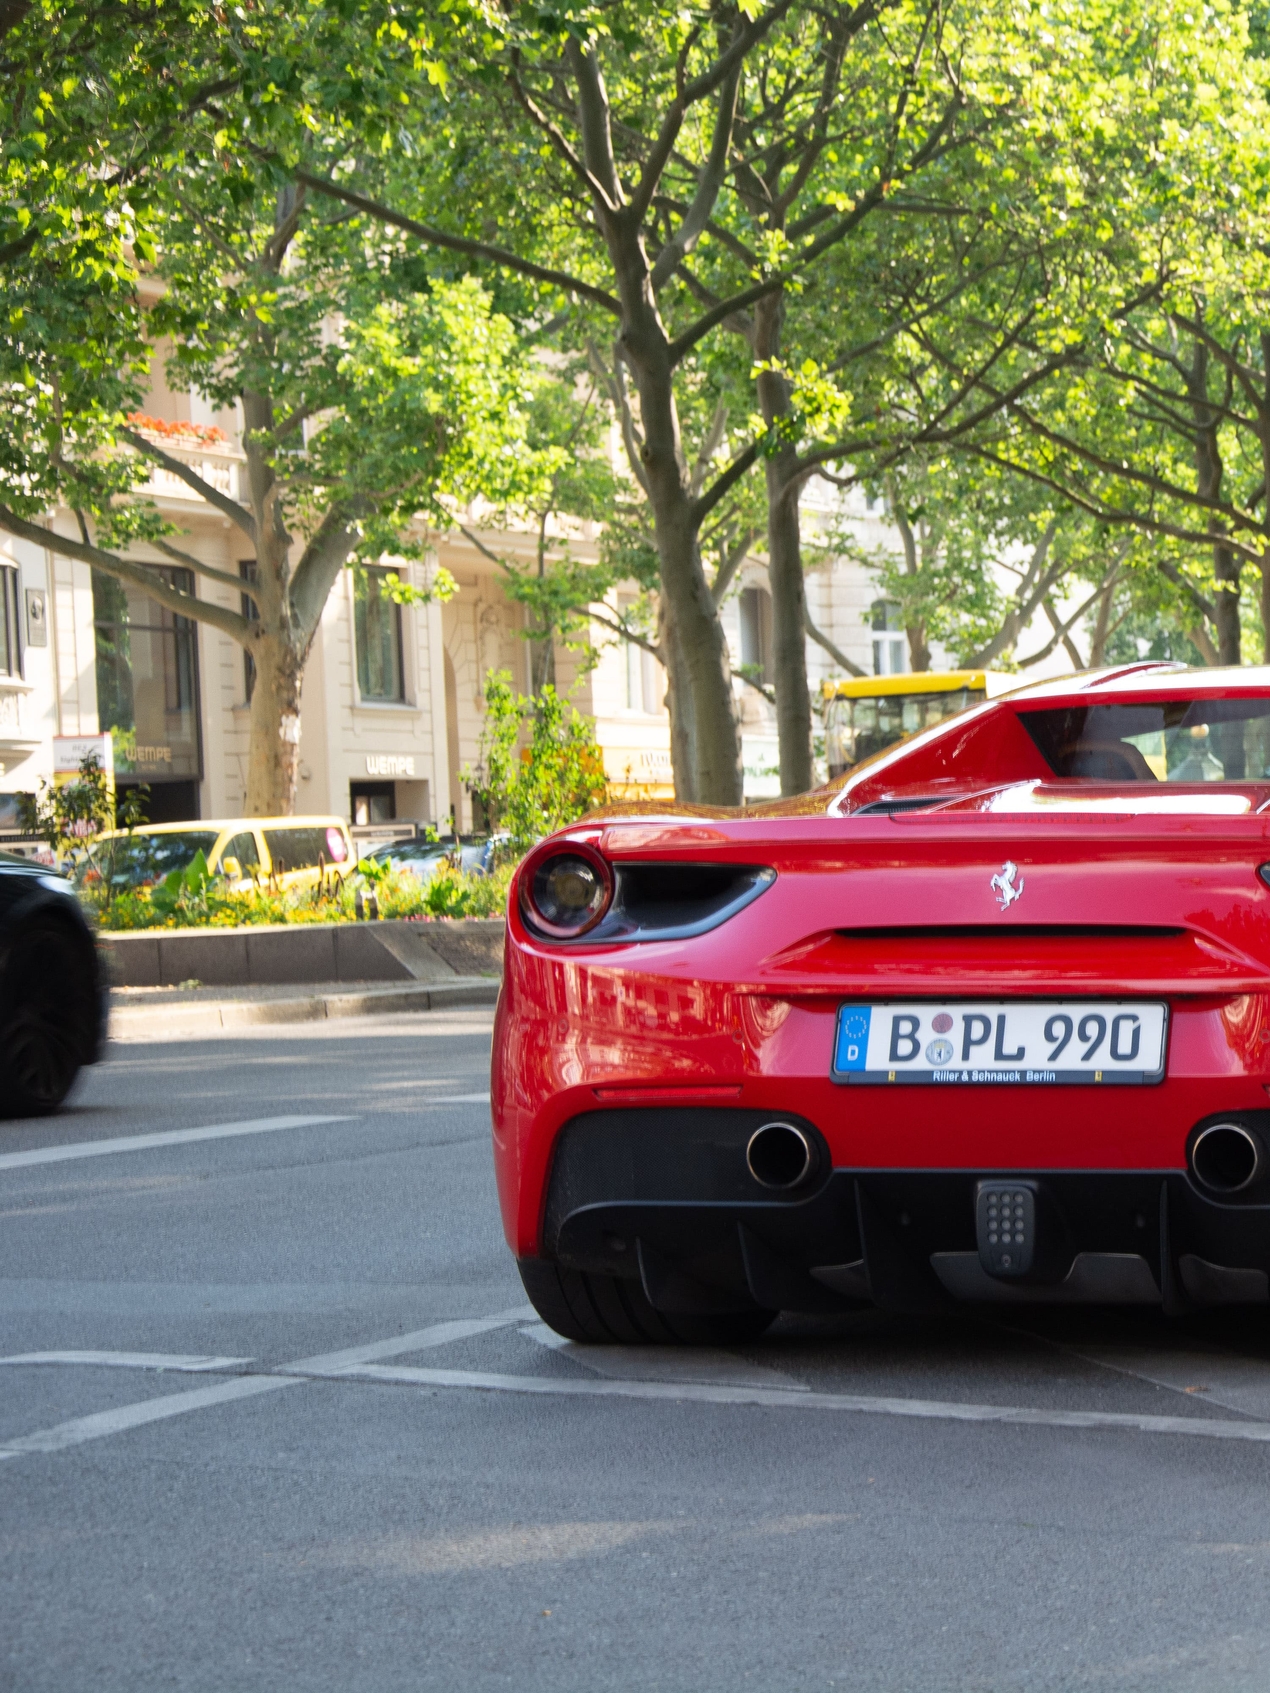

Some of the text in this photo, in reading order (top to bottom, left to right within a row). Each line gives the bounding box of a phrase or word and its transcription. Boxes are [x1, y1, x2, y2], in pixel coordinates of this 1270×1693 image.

[125, 746, 172, 763] WEMPE
[366, 755, 415, 776] WEMPE
[888, 1014, 1141, 1062] B PL 990
[847, 1044, 859, 1061] D
[933, 1070, 1056, 1082] Riller & Schnauck Berlin
